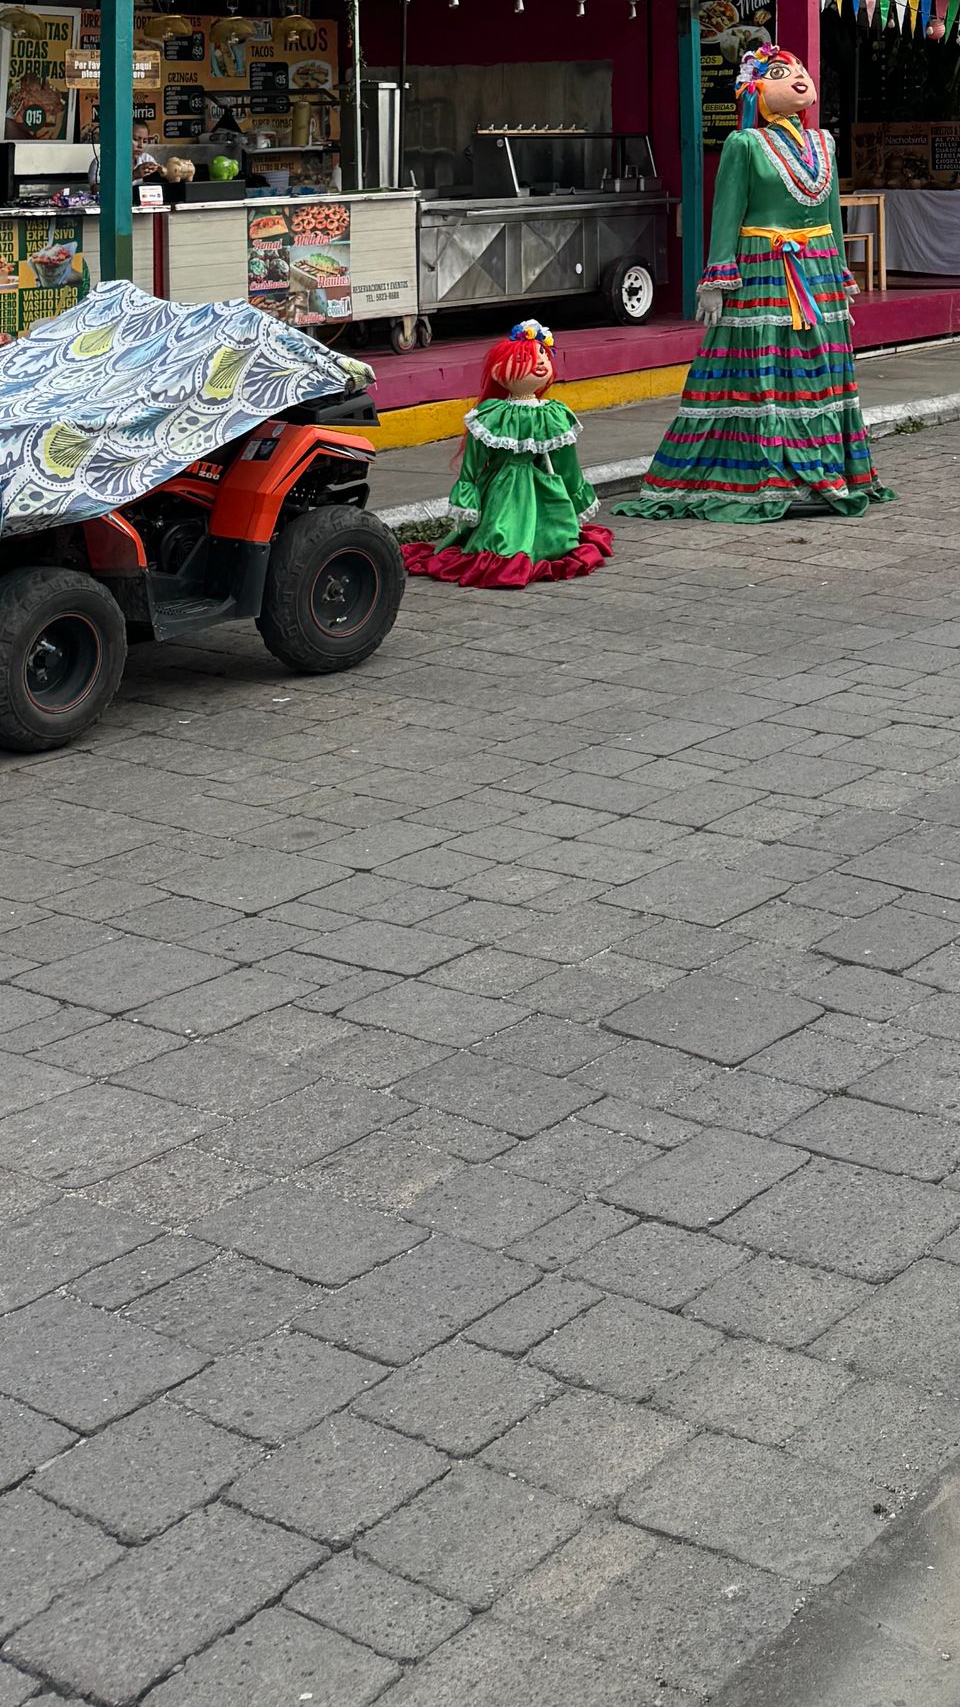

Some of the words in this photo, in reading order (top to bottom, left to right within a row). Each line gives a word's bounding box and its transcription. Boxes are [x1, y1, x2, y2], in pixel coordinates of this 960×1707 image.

[11, 40, 48, 59] LOCAS
[251, 46, 274, 57] TACOS
[75, 61, 87, 70] Por
[167, 72, 198, 83] GRINGAS
[26, 110, 42, 126] Q15
[26, 220, 49, 230] VASO
[26, 229, 75, 240] EXPLSIVO
[353, 283, 386, 293] RESERVACIONES
[390, 280, 409, 290] EVENTOS
[23, 289, 54, 301] VASITO
[23, 299, 54, 311] VASITO
[185, 461, 223, 475] ATV
[198, 470, 220, 480] 200
